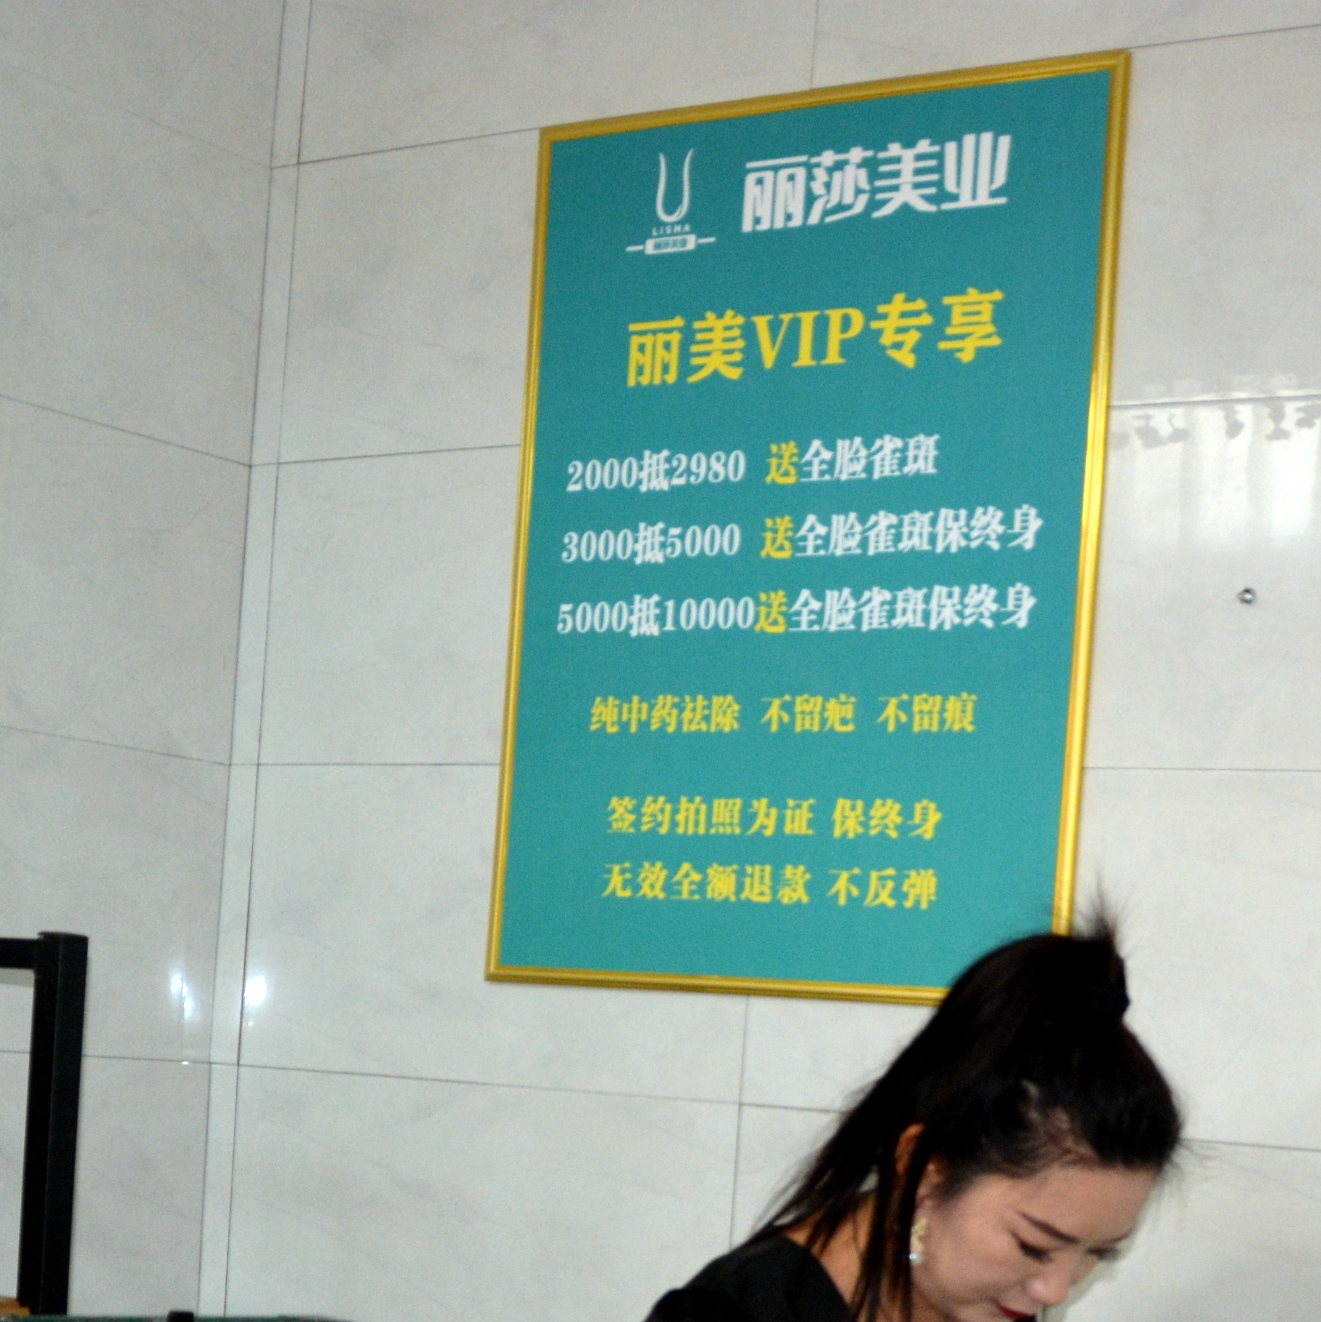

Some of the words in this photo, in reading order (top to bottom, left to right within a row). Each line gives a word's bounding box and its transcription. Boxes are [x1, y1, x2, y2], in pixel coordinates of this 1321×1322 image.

[740, 130, 1013, 234] 丽莎美业
[626, 287, 1006, 388] 丽美VIP专享
[566, 449, 747, 493] 2000抵2980
[560, 521, 742, 565] 3000抵5000
[761, 503, 1045, 560] 送全脸雀斑保终身
[589, 694, 742, 734] 纯中药祛除
[760, 693, 857, 734] 不留疤
[876, 691, 978, 733] 不留痕
[606, 795, 818, 837] 签约拍照为证
[831, 797, 943, 840] 保终身
[601, 860, 812, 905] 无效全额退款
[826, 866, 939, 910] 不反弹
